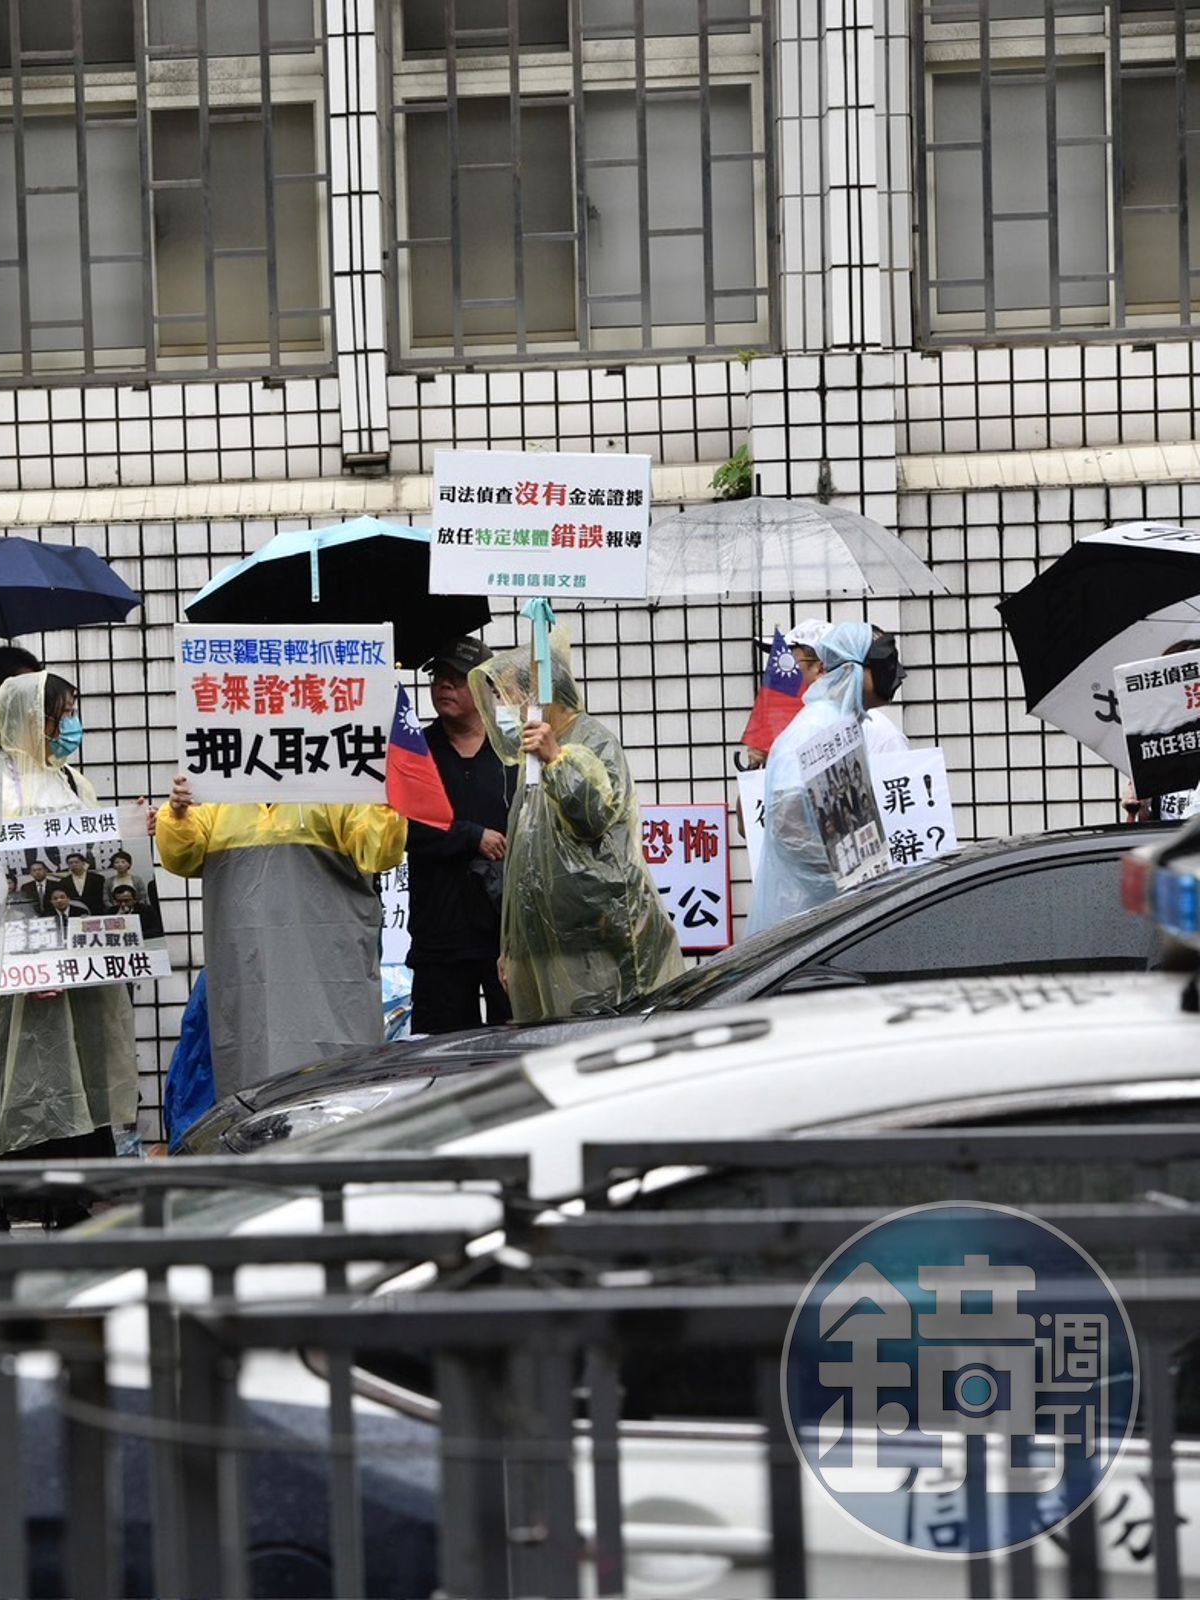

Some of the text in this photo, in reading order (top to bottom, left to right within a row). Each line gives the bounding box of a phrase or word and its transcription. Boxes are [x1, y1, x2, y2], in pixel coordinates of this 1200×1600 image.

[439, 481, 644, 507] 司法偵查沒有金流證據
[436, 523, 643, 549] 放任特定媒體錯誤報導
[487, 573, 587, 588] #我相信柯文哲
[185, 723, 387, 783] 押人取供
[1140, 731, 1200, 761] 放任特
[43, 812, 117, 838] 押人取供
[642, 819, 719, 864] 恐怖
[56, 952, 153, 984] 押人取供
